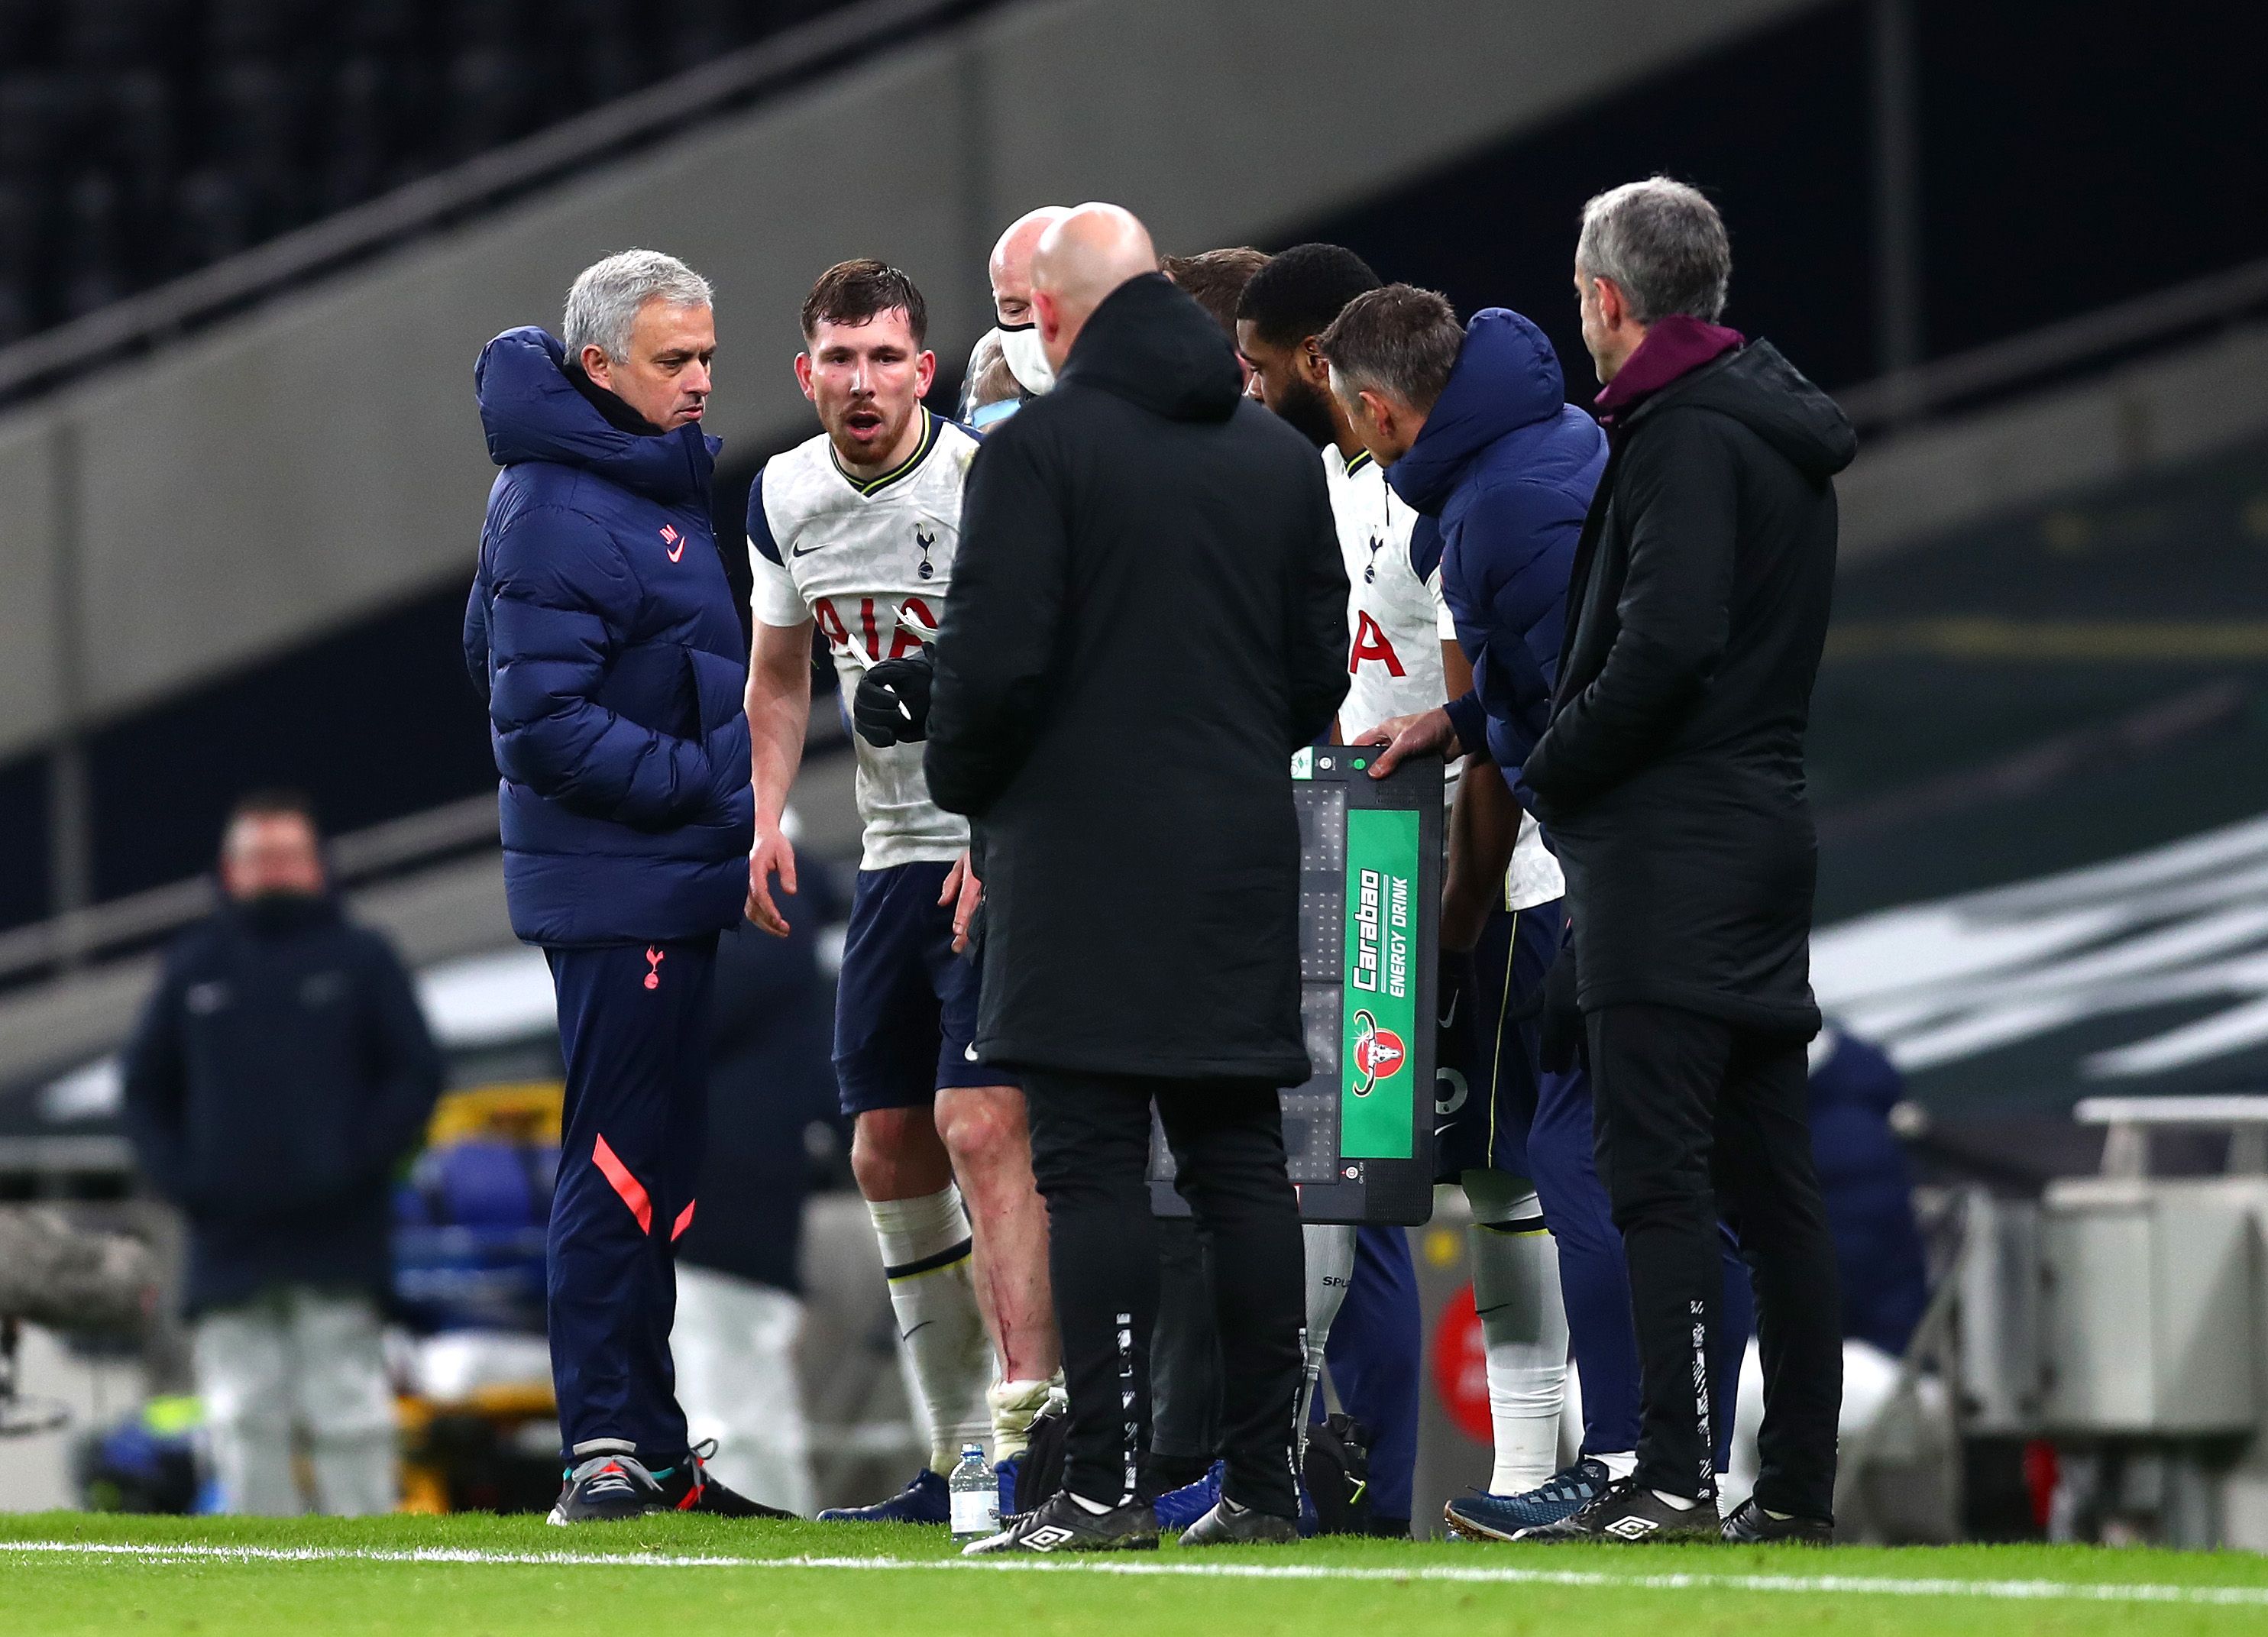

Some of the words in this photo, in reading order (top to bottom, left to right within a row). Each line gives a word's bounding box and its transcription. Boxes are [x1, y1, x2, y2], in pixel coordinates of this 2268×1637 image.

[659, 523, 678, 545] JM
[1352, 868, 1380, 992] Carabao
[1391, 875, 1408, 928] DRINK
[1390, 930, 1406, 998] ENERGY
